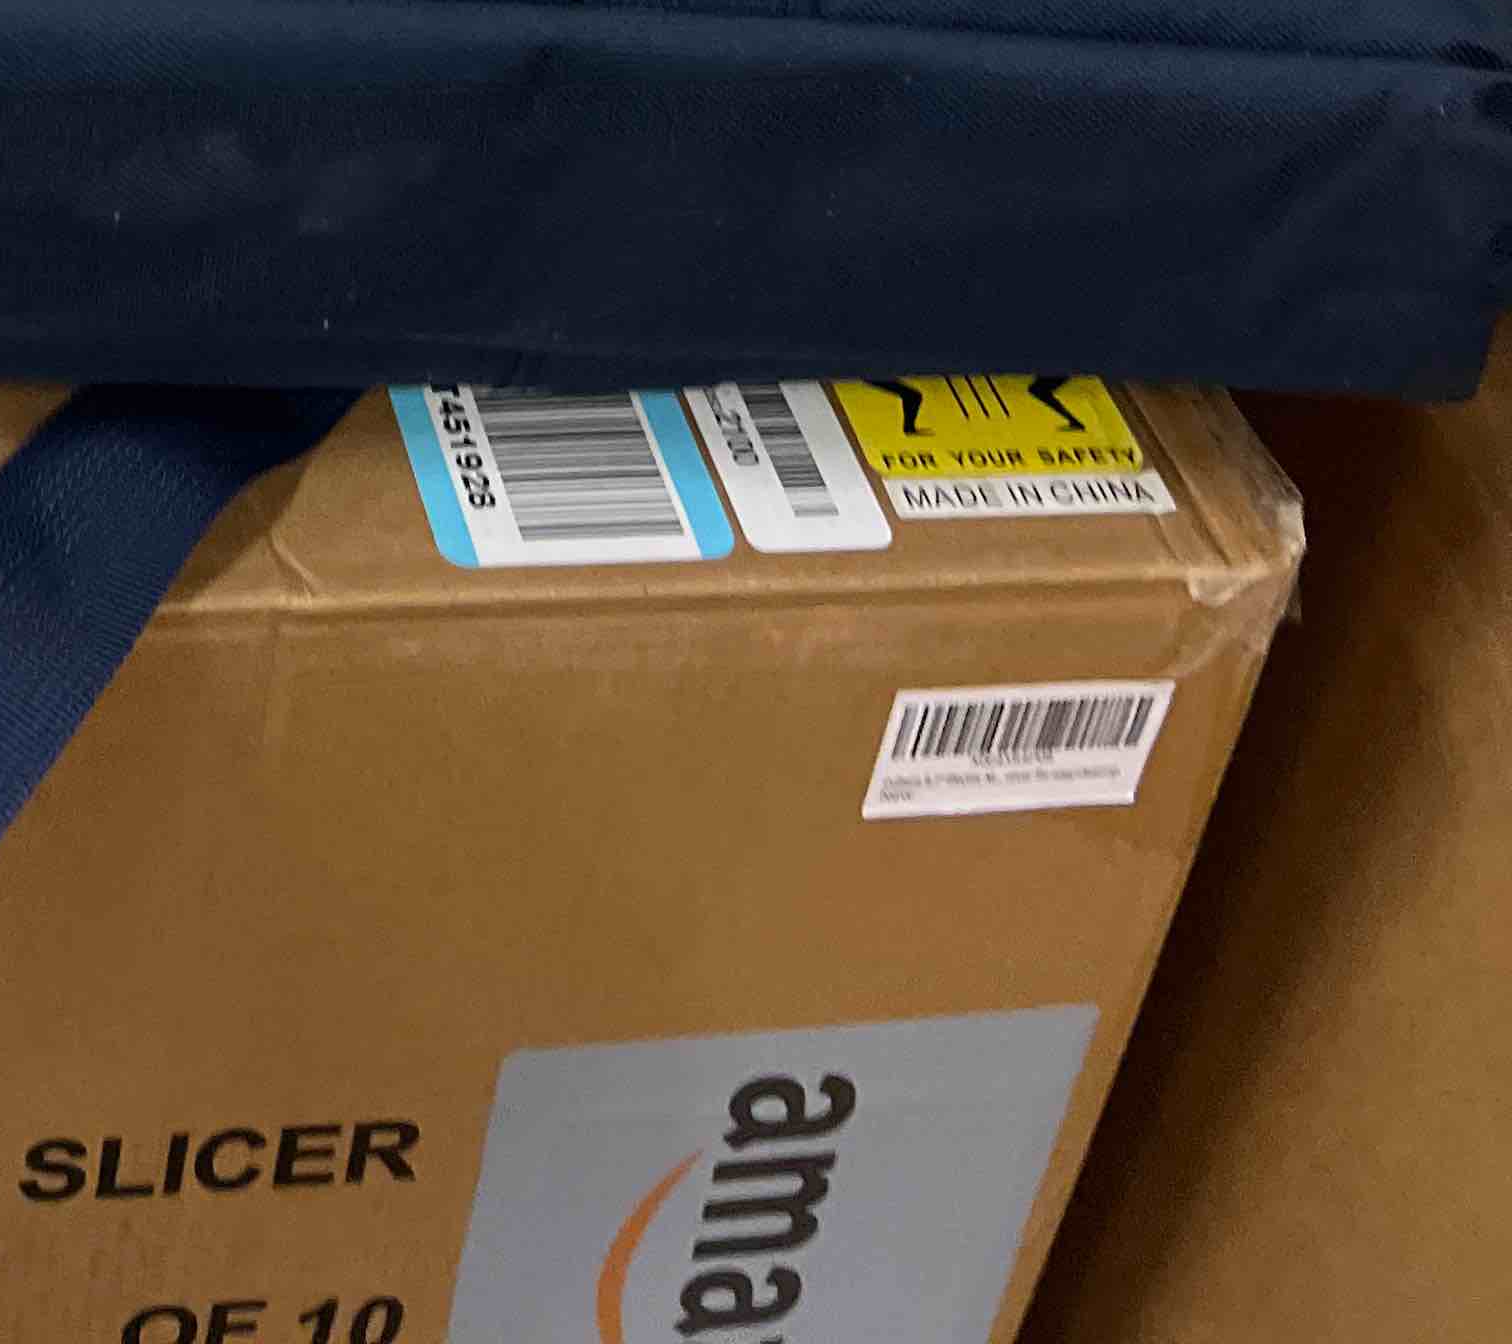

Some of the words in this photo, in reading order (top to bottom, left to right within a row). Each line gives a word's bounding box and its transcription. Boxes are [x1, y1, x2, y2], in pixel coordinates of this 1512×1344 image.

[882, 453, 935, 471] FOR
[950, 448, 1023, 468] YOUR
[1037, 445, 1137, 467] SAFETY
[902, 485, 1003, 509] MADE
[1007, 484, 1044, 506] IN
[1051, 479, 1156, 505] CHINA
[19, 1119, 420, 1203] SLICER
[673, 1074, 856, 1344] ama
